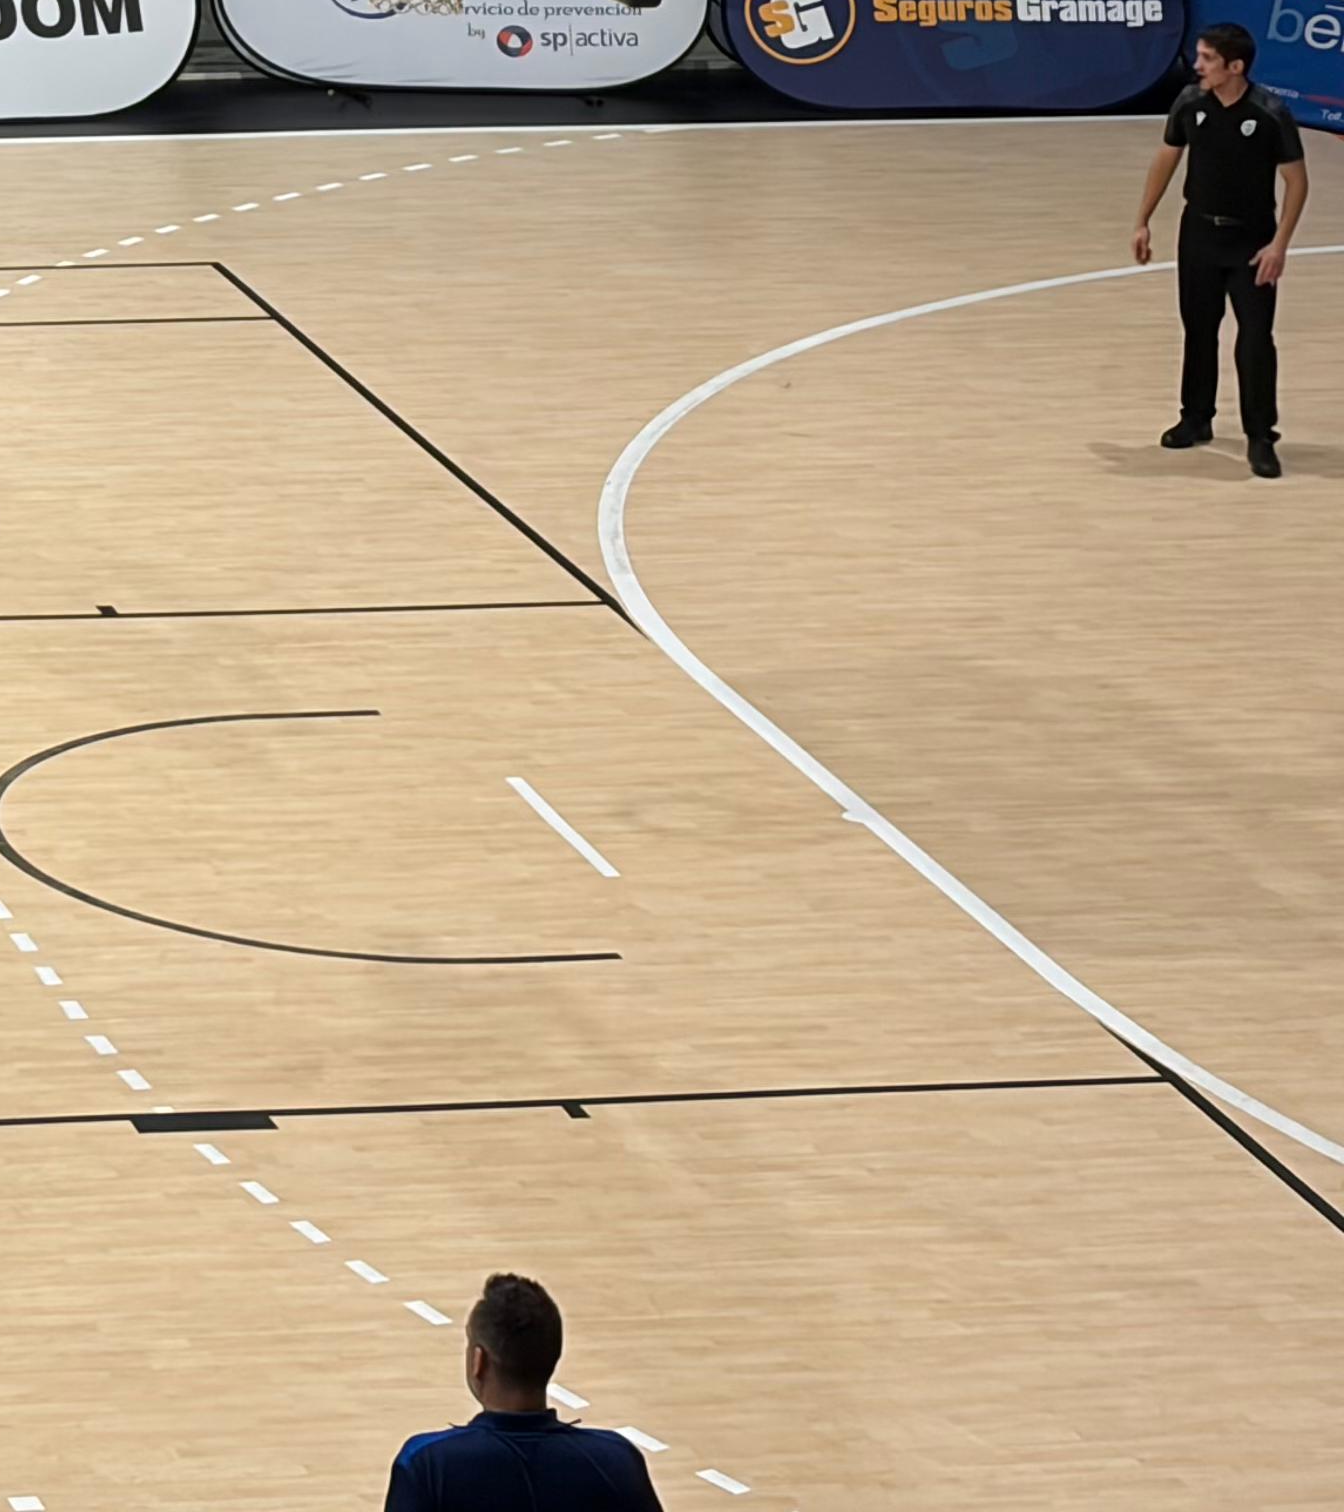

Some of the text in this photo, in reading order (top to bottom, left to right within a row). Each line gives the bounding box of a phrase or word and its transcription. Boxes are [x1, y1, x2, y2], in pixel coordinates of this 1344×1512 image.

[464, 2, 513, 17] rvicio
[517, 0, 540, 17] de
[467, 22, 486, 39] by
